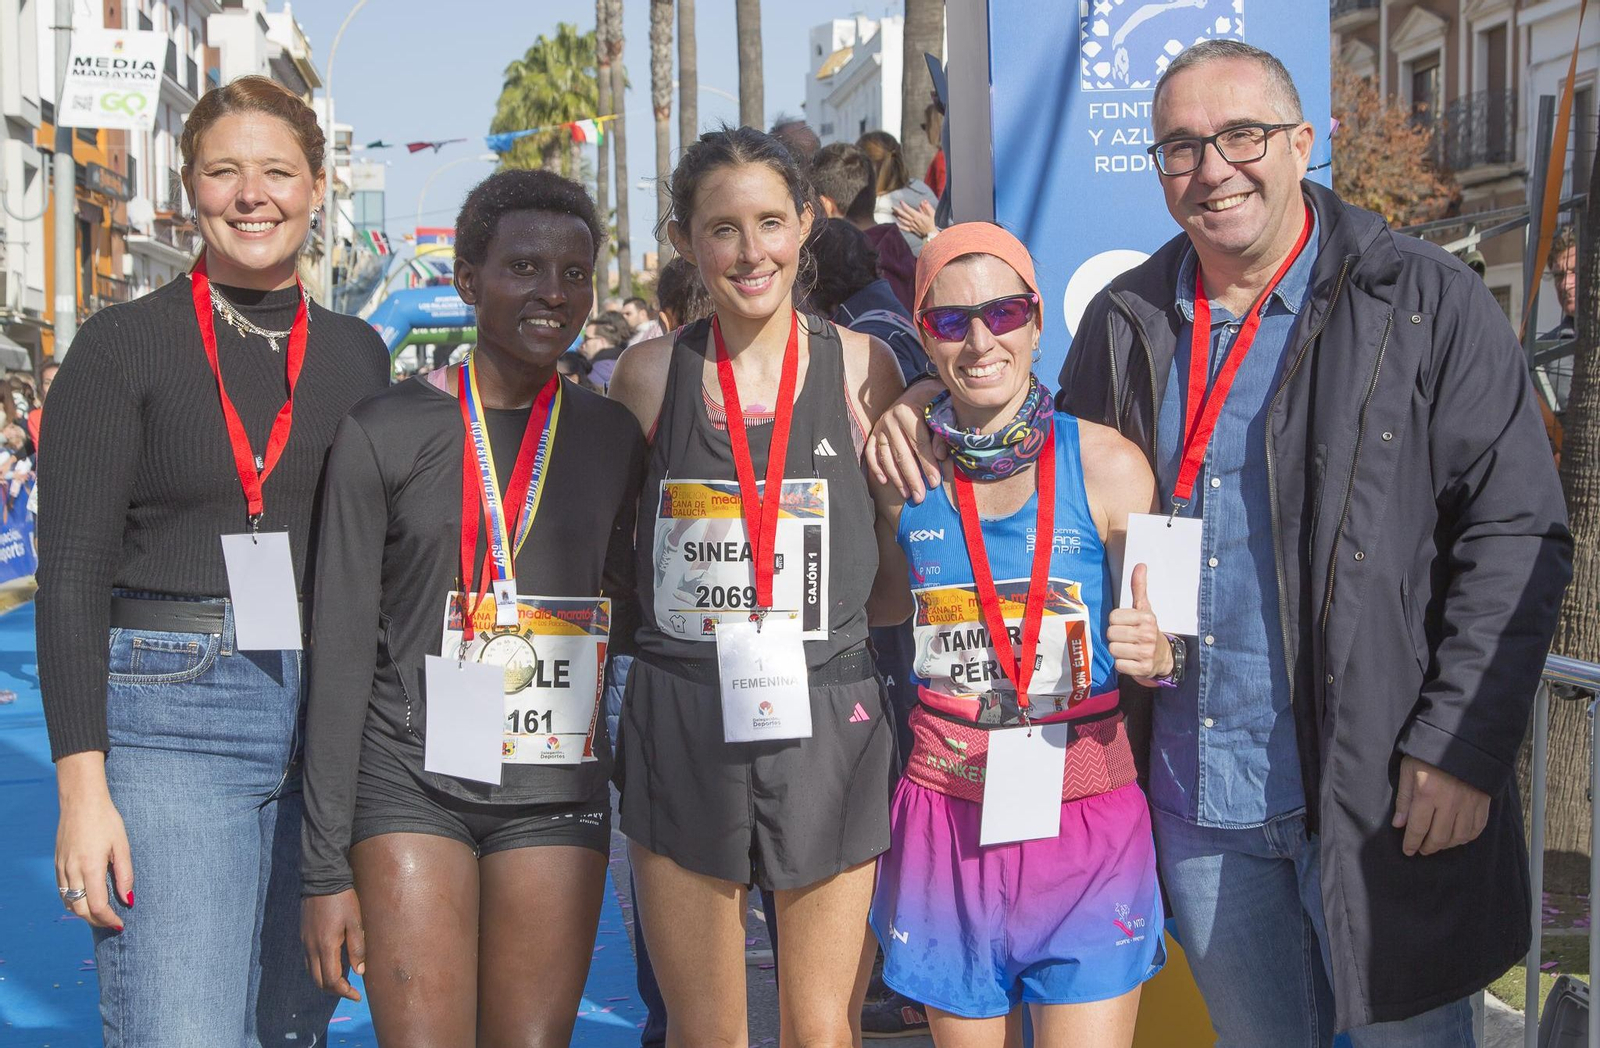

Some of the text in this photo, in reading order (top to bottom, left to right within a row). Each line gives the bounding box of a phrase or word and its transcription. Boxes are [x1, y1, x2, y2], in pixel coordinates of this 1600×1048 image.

[74, 57, 156, 71] MEDIA
[1089, 101, 1153, 119] FONT
[1088, 127, 1155, 146] Y AZU
[470, 421, 490, 471] MARATÓN
[482, 473, 497, 508] MEDIA
[525, 480, 540, 511] MEDIA
[694, 501, 706, 509] DE
[1026, 534, 1081, 546] SANE
[683, 542, 755, 562] SINEA
[805, 551, 818, 605] CAJÓN 1
[695, 586, 758, 608] 2069
[950, 604, 964, 613] DE
[938, 627, 1042, 653] TAMR
[950, 657, 1022, 684] PÉR
[1071, 638, 1087, 701] CAJÓN ÉLITE
[732, 676, 799, 690] FEMENINA
